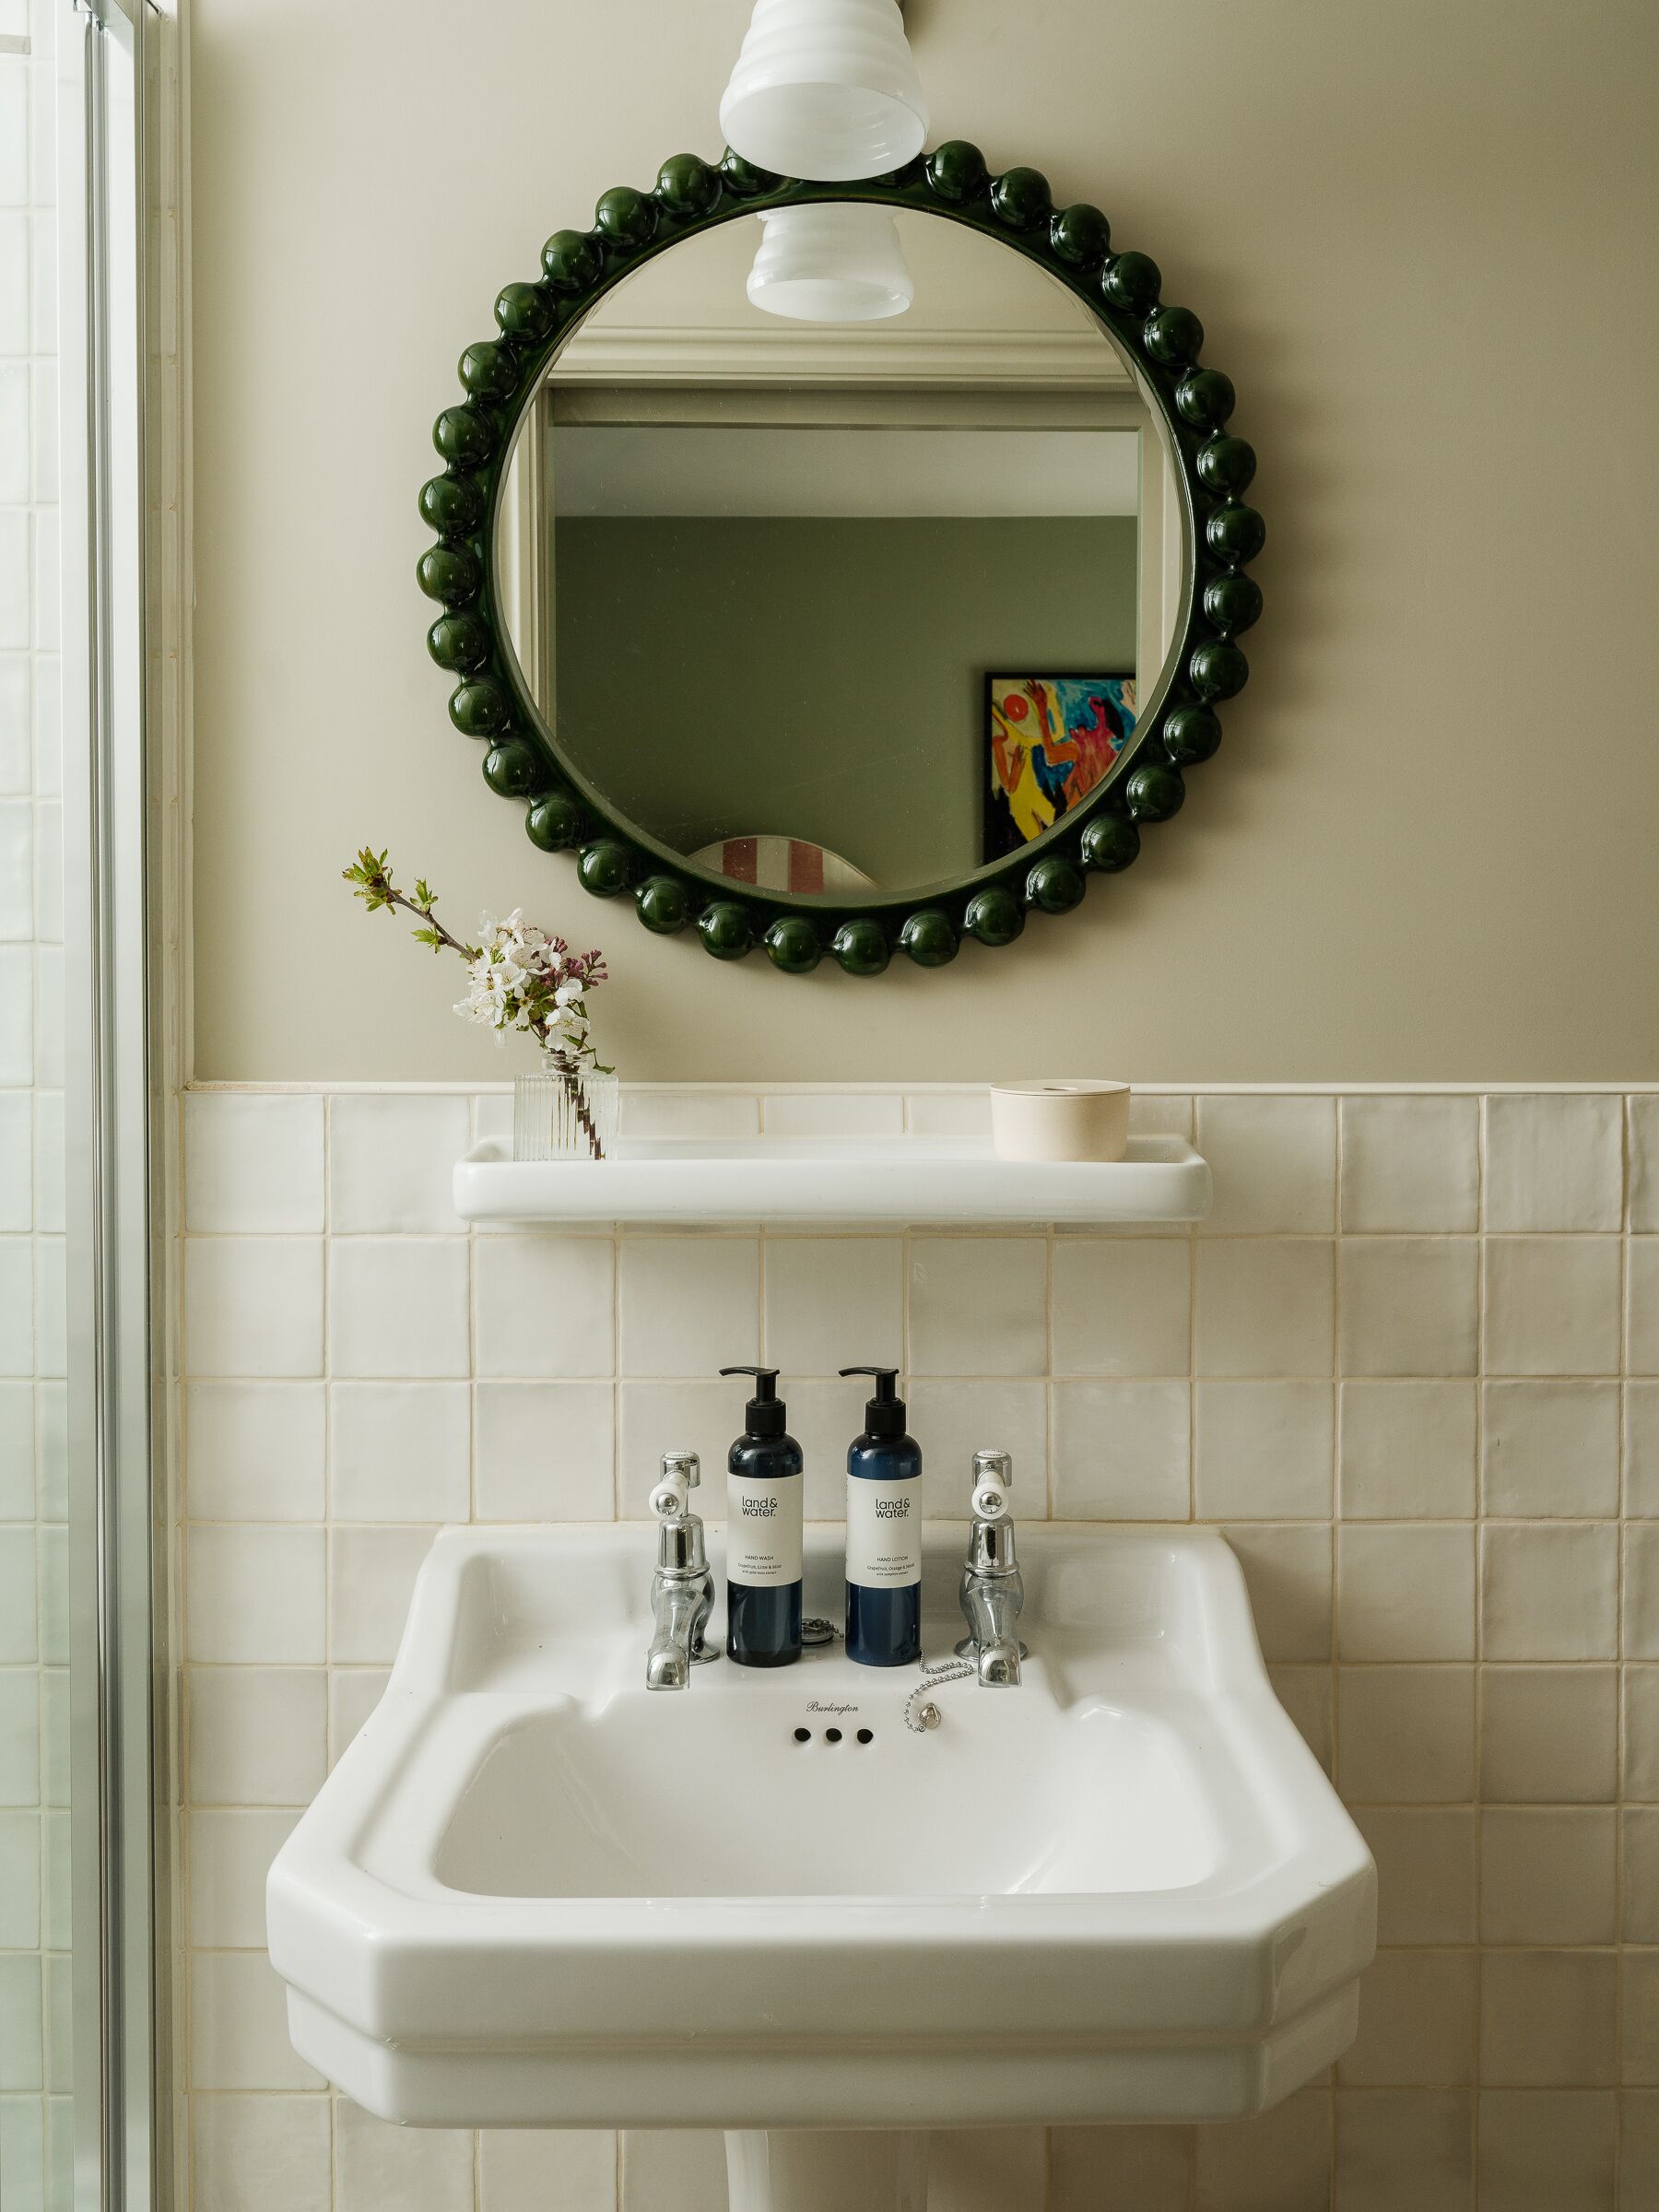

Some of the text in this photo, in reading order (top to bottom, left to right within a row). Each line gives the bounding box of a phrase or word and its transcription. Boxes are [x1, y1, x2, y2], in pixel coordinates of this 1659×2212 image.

[741, 1508, 776, 1517] water.
[876, 1509, 909, 1518] water.
[806, 1700, 859, 1716] Burlington
